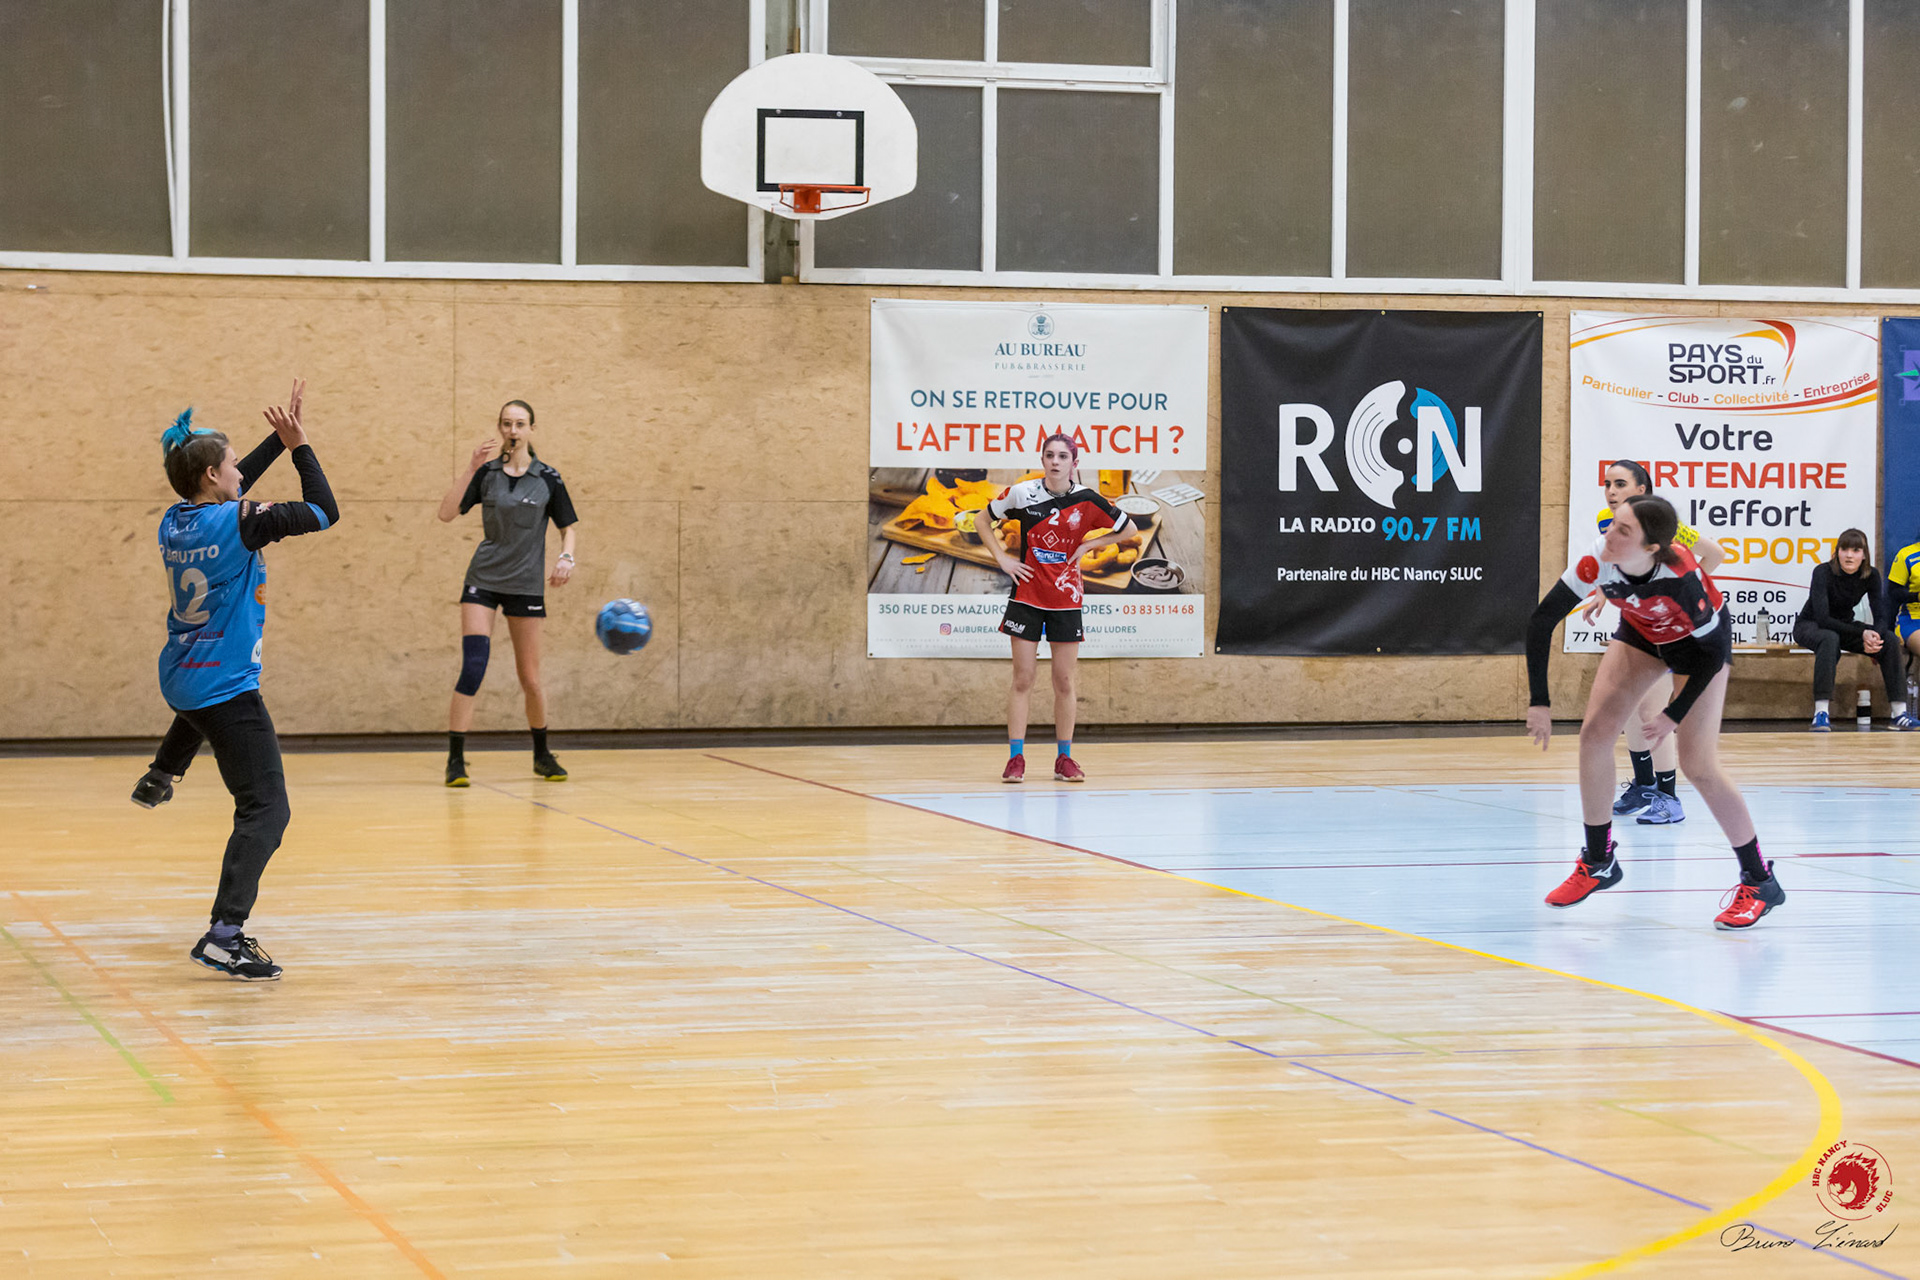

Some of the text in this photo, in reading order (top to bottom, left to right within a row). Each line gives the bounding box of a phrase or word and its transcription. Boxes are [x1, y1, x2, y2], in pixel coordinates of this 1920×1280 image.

[995, 342, 1086, 357] AU BUREAU
[1668, 343, 1762, 364] PAYS du
[1582, 371, 1870, 405] Particulier Club Collectivité Entreprise
[910, 389, 1168, 410] ON SE RETROUVE POUR
[896, 421, 1025, 452] L'AFTER
[1674, 423, 1773, 450] Votre
[1048, 508, 1060, 526] 2
[1690, 499, 1812, 528] l'effort
[1280, 516, 1482, 541] LA RADIO 90.7 FM
[166, 545, 220, 564] BRUTTO
[1278, 566, 1483, 584] Partenaire du HBC Nancy SLUC
[166, 566, 210, 625] 12
[1736, 590, 1758, 602] 68
[1764, 590, 1786, 602] 06
[879, 604, 900, 614] 350
[904, 604, 928, 614] RUE
[931, 604, 954, 614] DES
[1123, 605, 1136, 615] 03
[1140, 605, 1152, 615] 83
[1154, 605, 1165, 615] 51
[1168, 605, 1178, 615] 14
[1181, 605, 1194, 615] 68
[1572, 632, 1590, 642] 77
